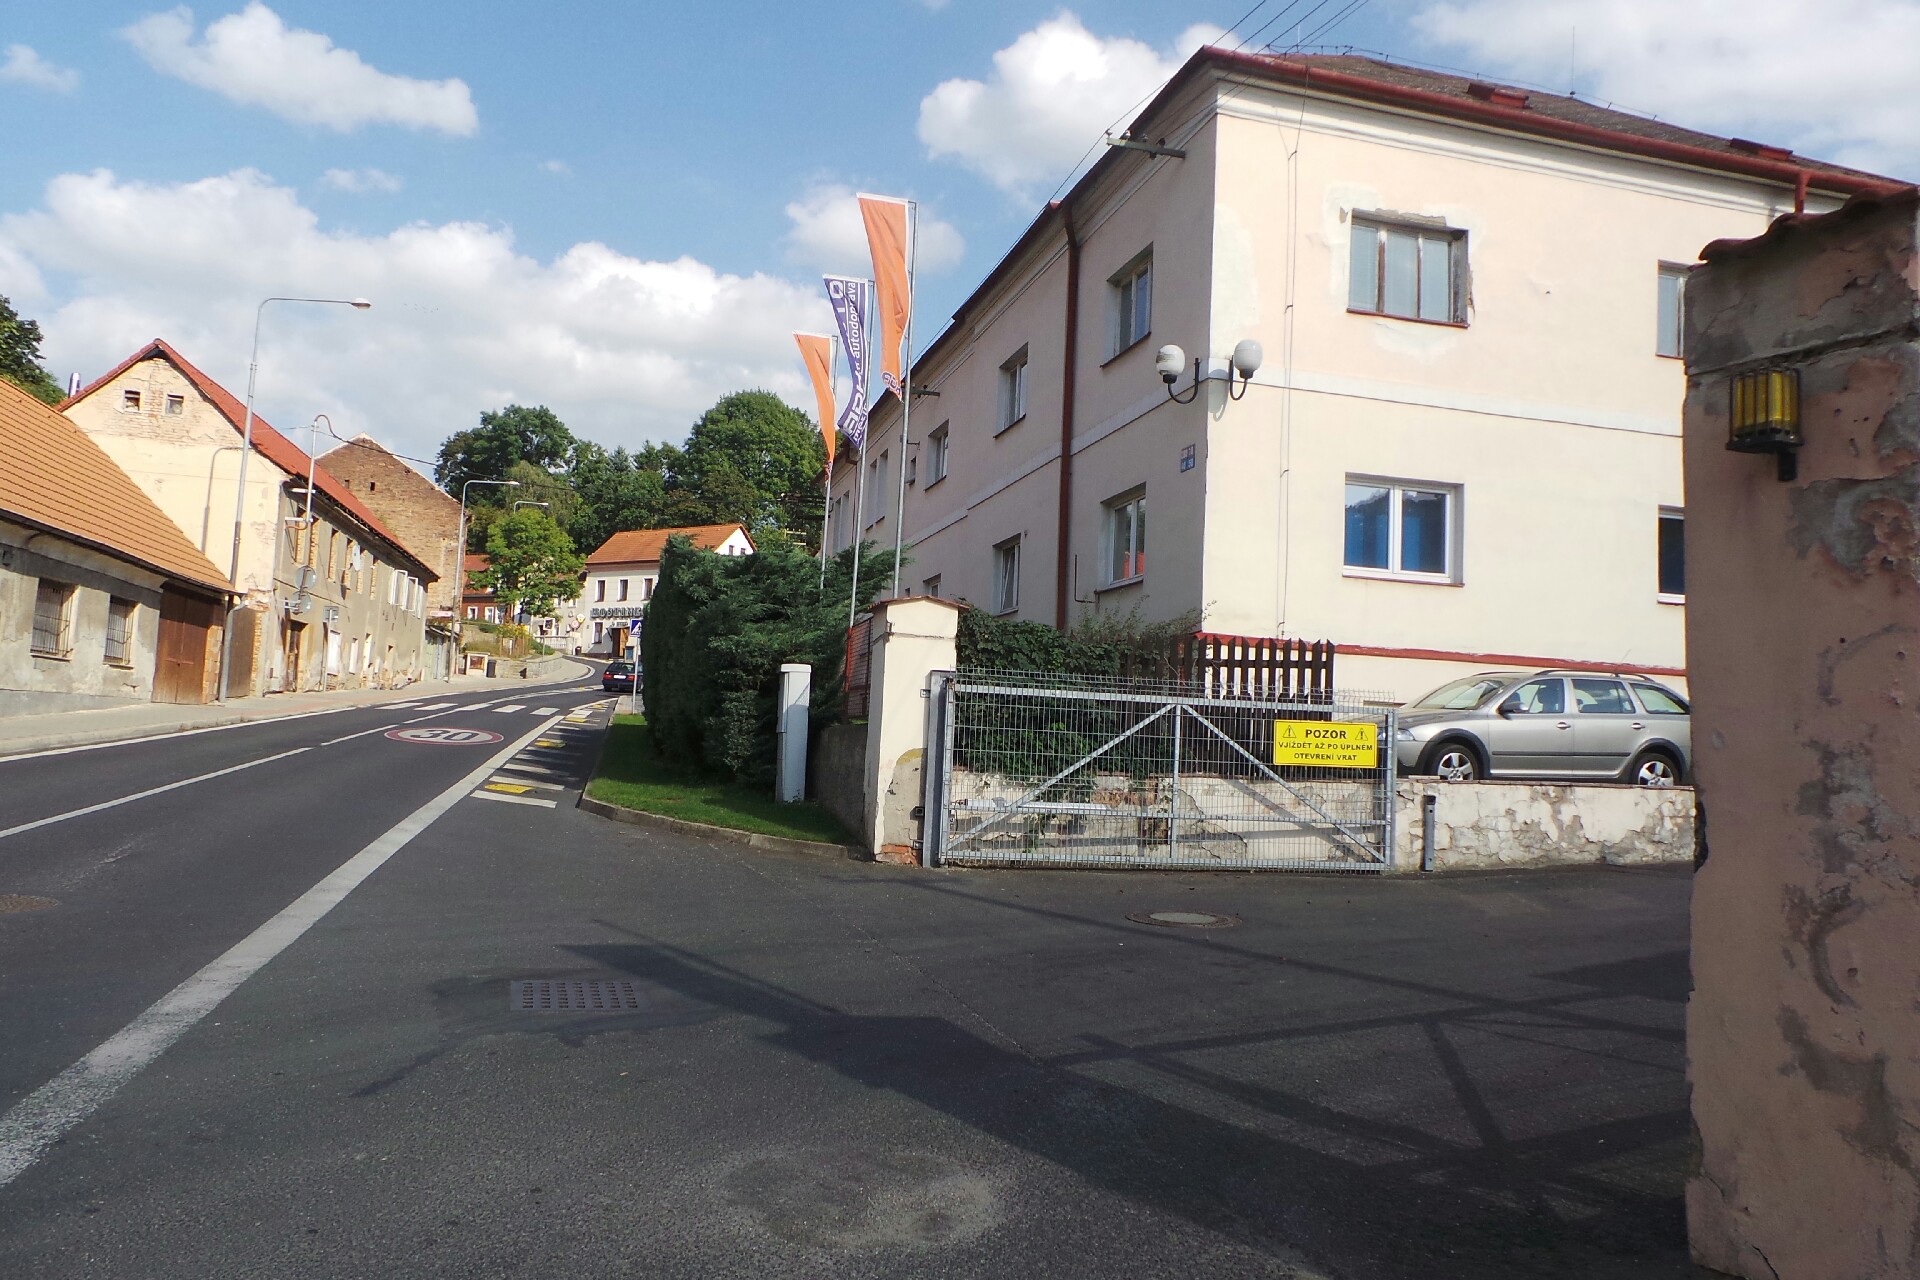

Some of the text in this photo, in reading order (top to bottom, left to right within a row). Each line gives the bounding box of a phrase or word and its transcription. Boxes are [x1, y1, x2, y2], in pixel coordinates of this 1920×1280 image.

[847, 282, 861, 358] autodoprava
[409, 729, 480, 741] 30
[1305, 729, 1347, 739] POZOR
